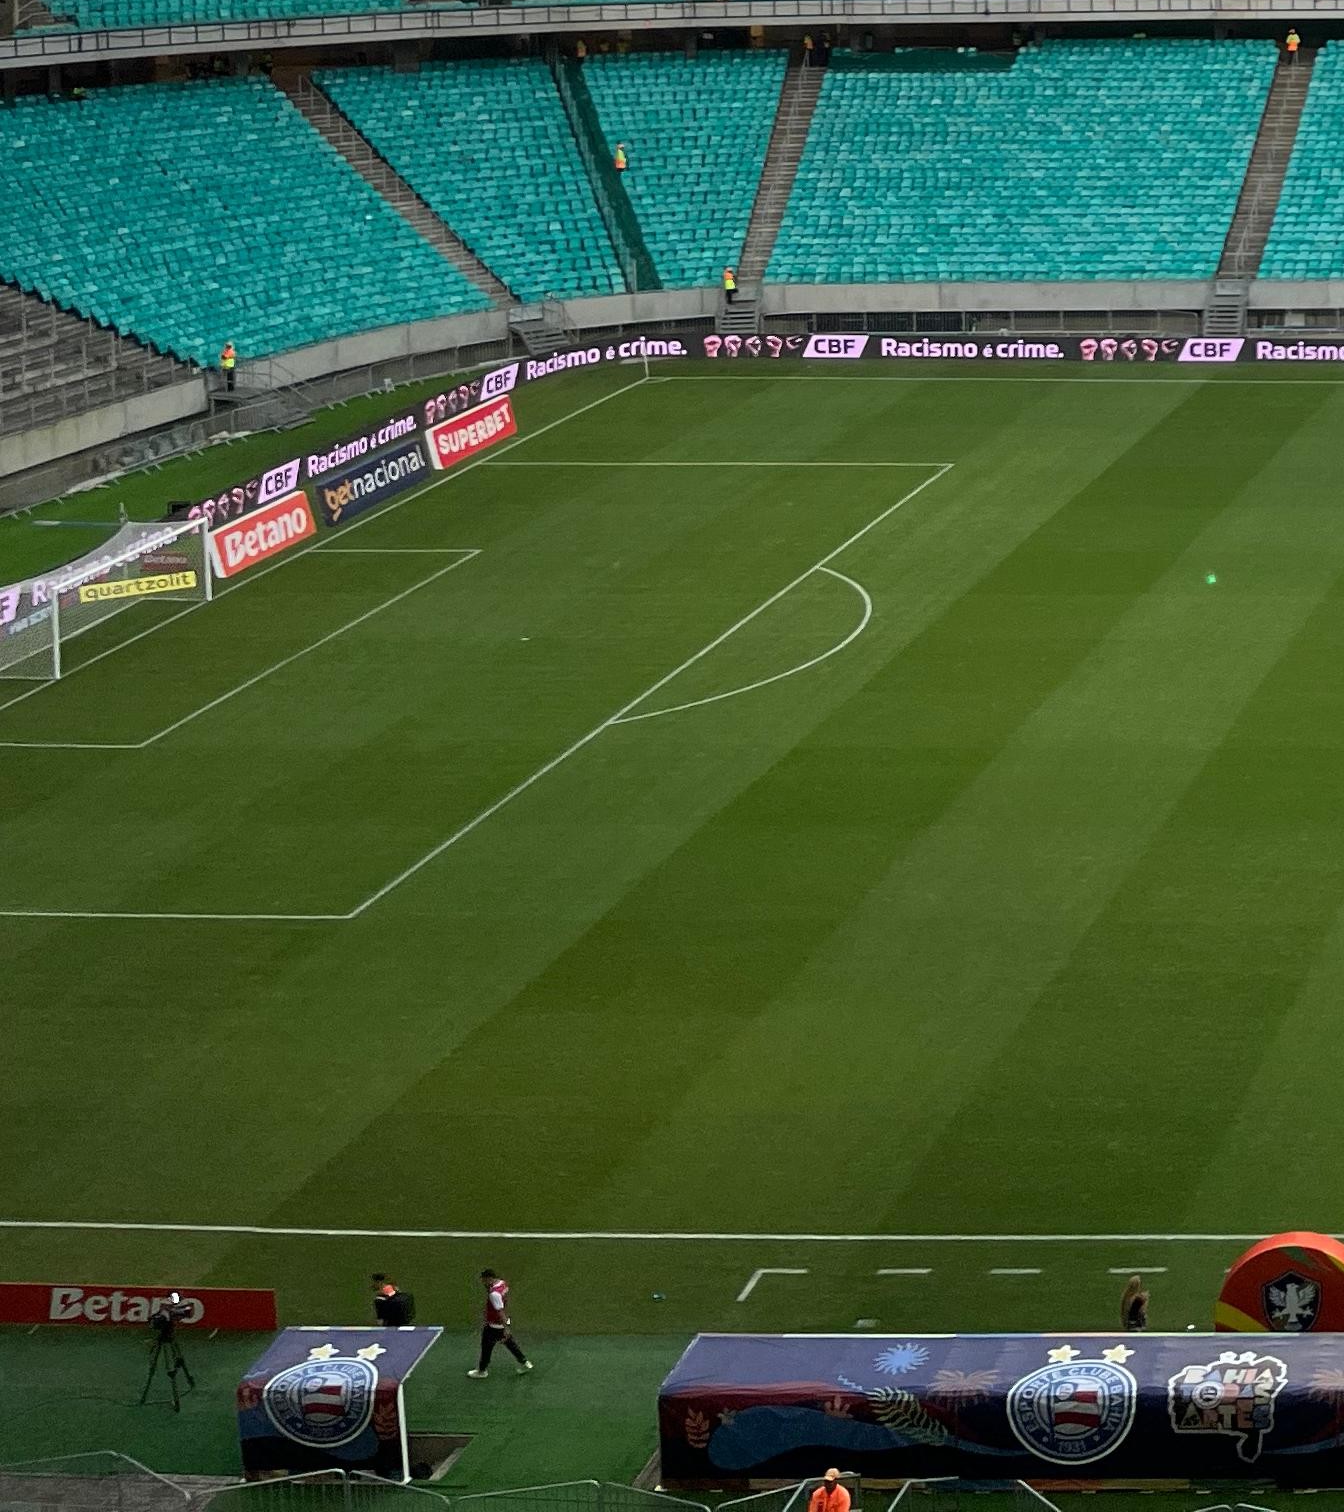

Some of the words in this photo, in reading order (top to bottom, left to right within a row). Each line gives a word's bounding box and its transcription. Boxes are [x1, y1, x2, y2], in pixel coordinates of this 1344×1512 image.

[526, 347, 600, 380] Racismo
[618, 336, 687, 357] crime.
[814, 339, 855, 354] CBF
[881, 338, 977, 358] Racismo
[995, 339, 1065, 359] crime.
[1190, 342, 1231, 357] CBF
[487, 371, 512, 394] CBF
[438, 403, 512, 455] SUPERBET
[307, 436, 368, 478] Racismo
[378, 415, 417, 445] crime.
[264, 466, 293, 496] CBF
[324, 444, 426, 518] betnacional
[224, 507, 307, 568] Betano
[85, 573, 192, 601] quartzolit
[1068, 1367, 1120, 1384] CLUBE
